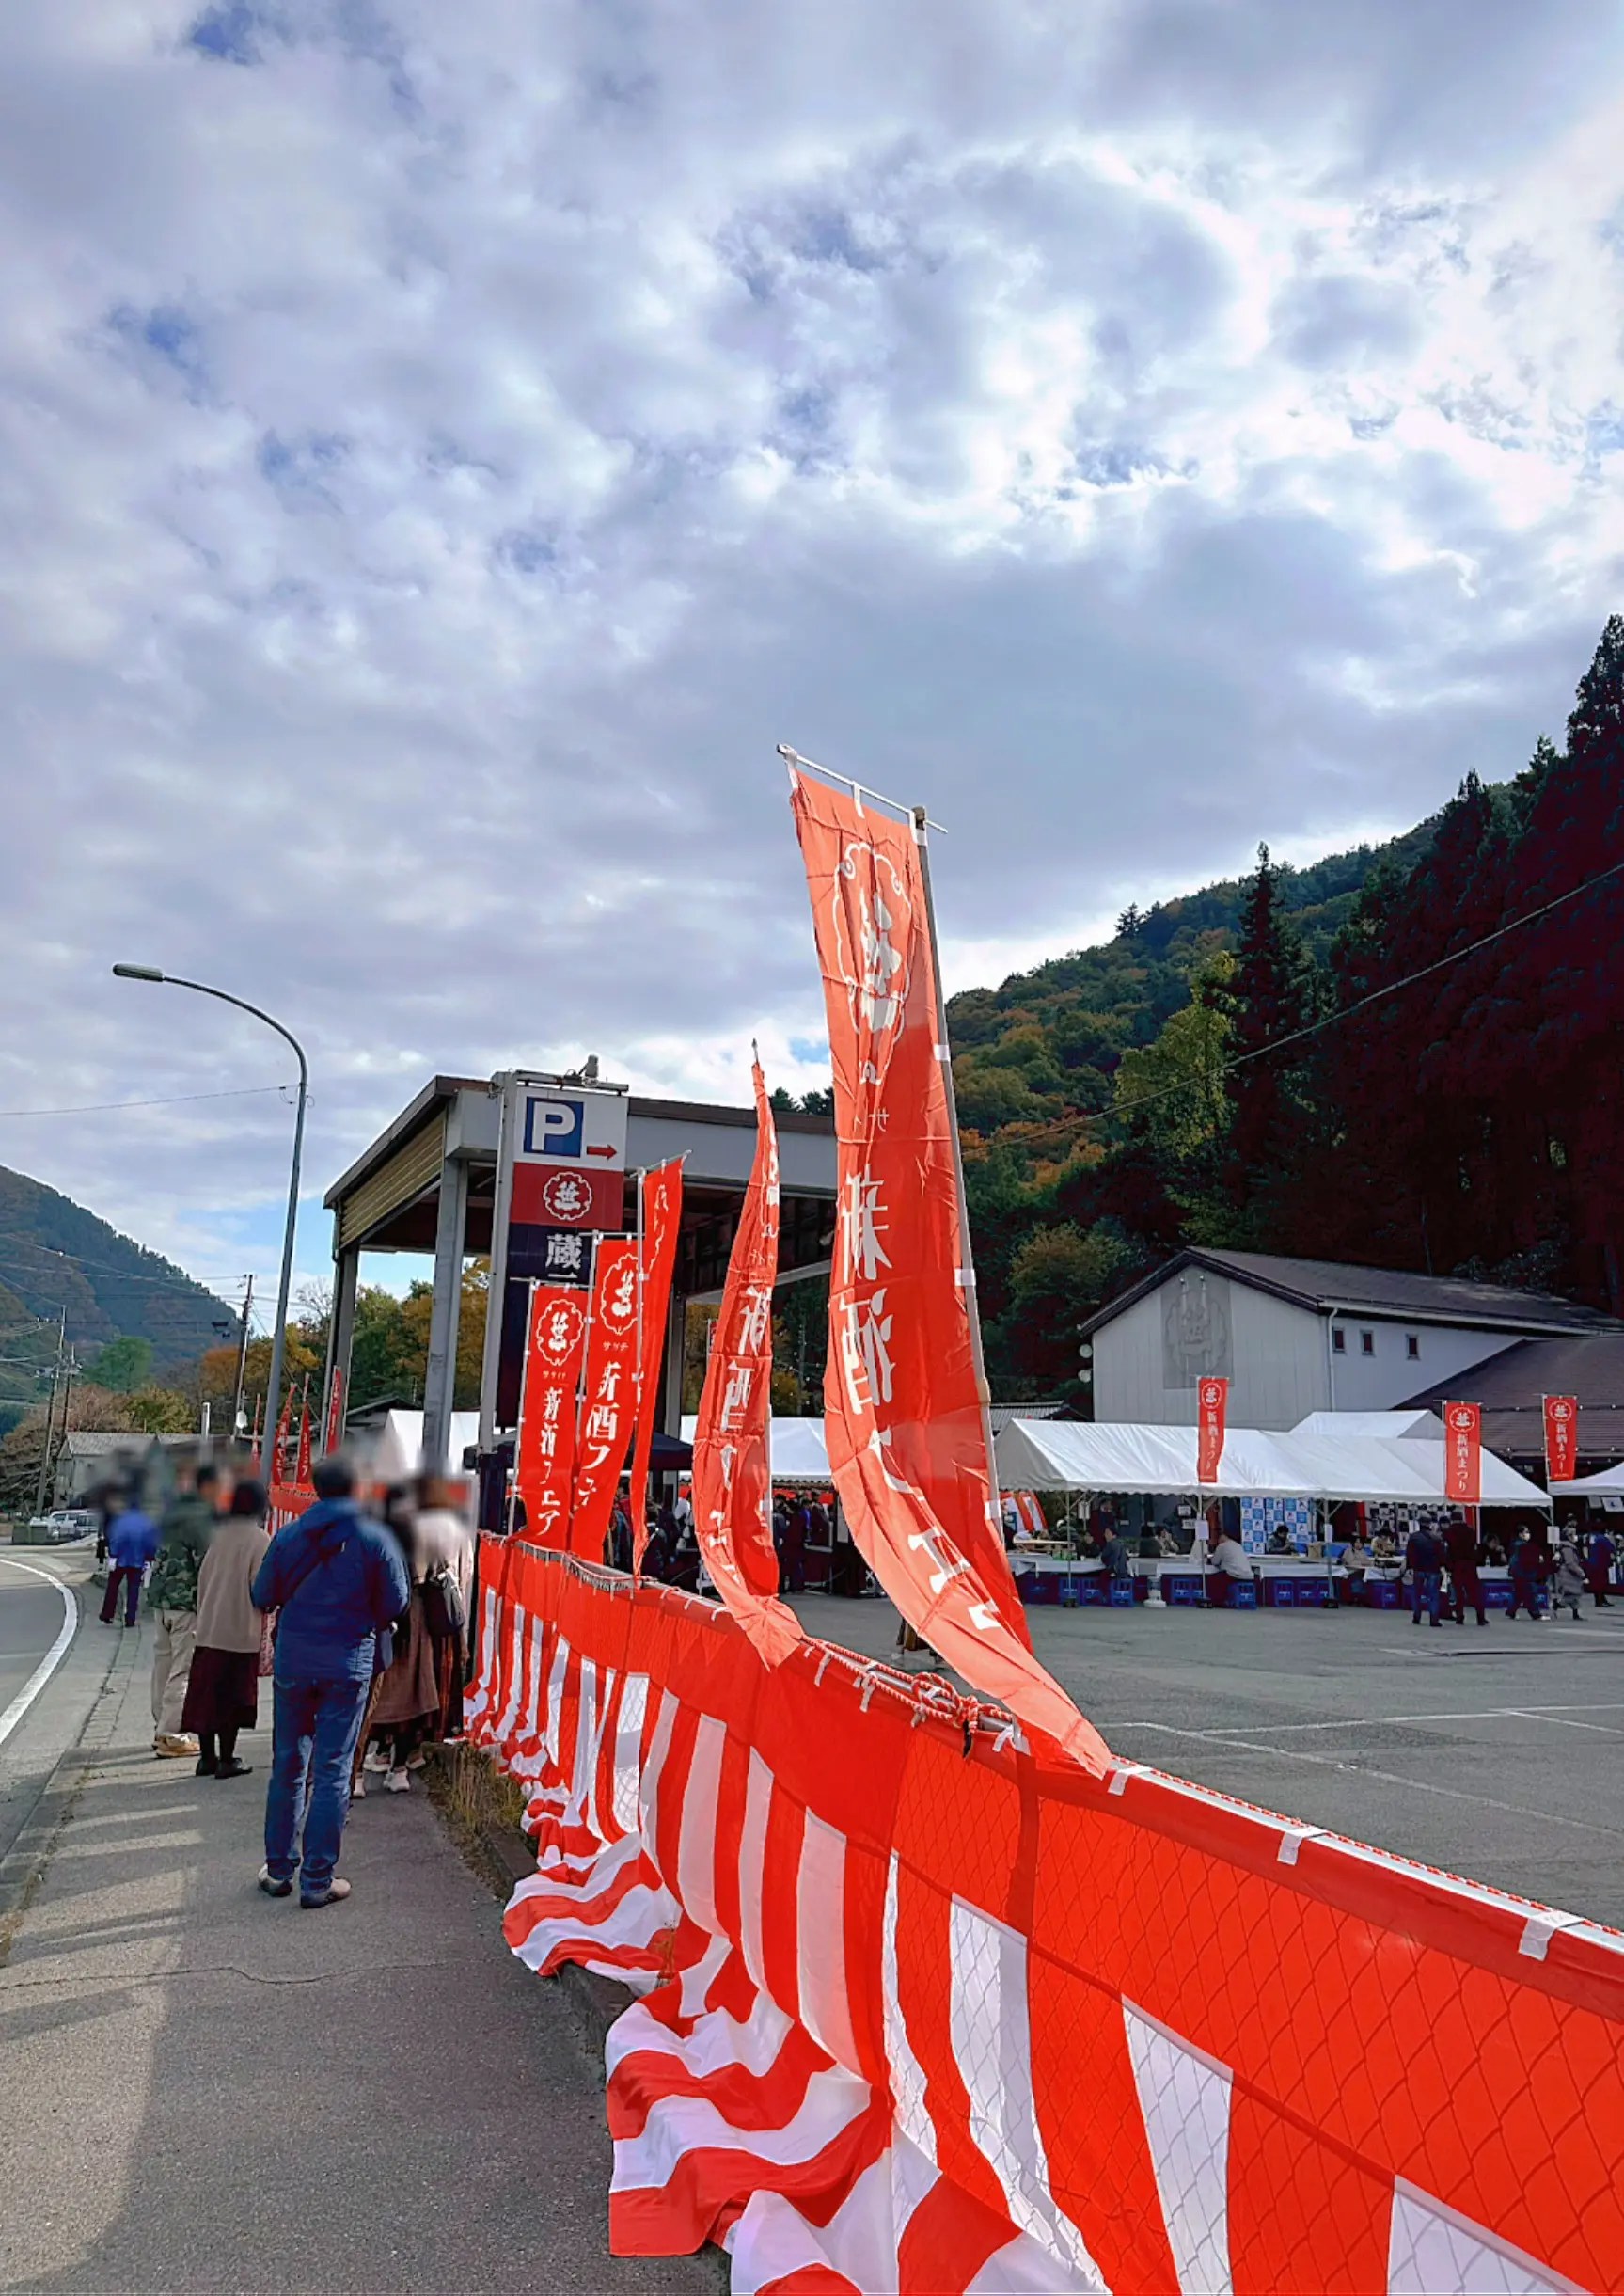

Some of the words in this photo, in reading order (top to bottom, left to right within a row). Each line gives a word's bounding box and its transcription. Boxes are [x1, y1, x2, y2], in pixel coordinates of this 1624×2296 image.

[531, 1101, 575, 1151] P
[1456, 1433, 1469, 1493] 新酒まつり
